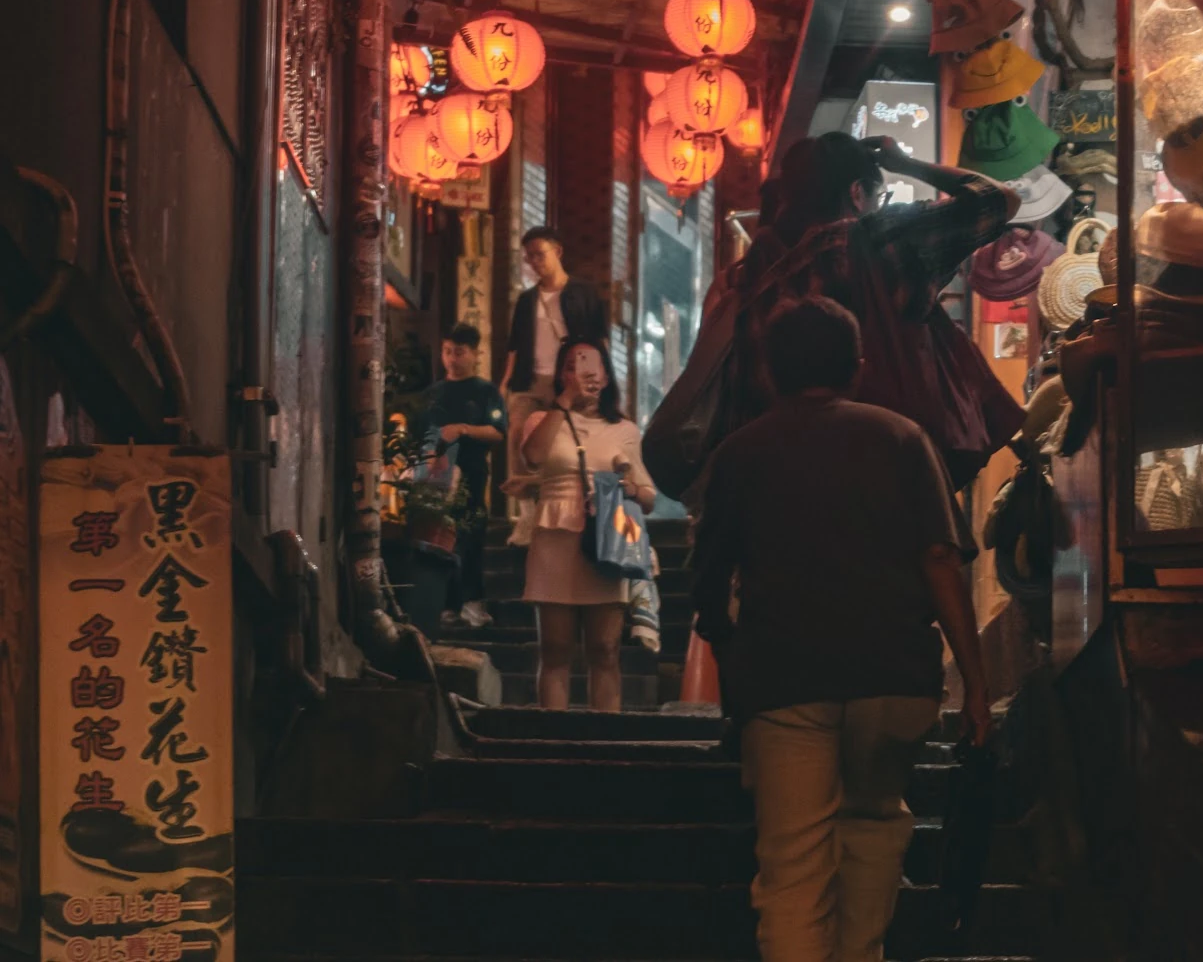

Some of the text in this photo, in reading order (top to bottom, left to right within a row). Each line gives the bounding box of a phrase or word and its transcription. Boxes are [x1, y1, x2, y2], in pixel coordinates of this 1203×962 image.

[490, 22, 514, 72] 九份
[68, 510, 127, 812] 第一名的花生
[139, 480, 210, 839] 黑金鑽花生
